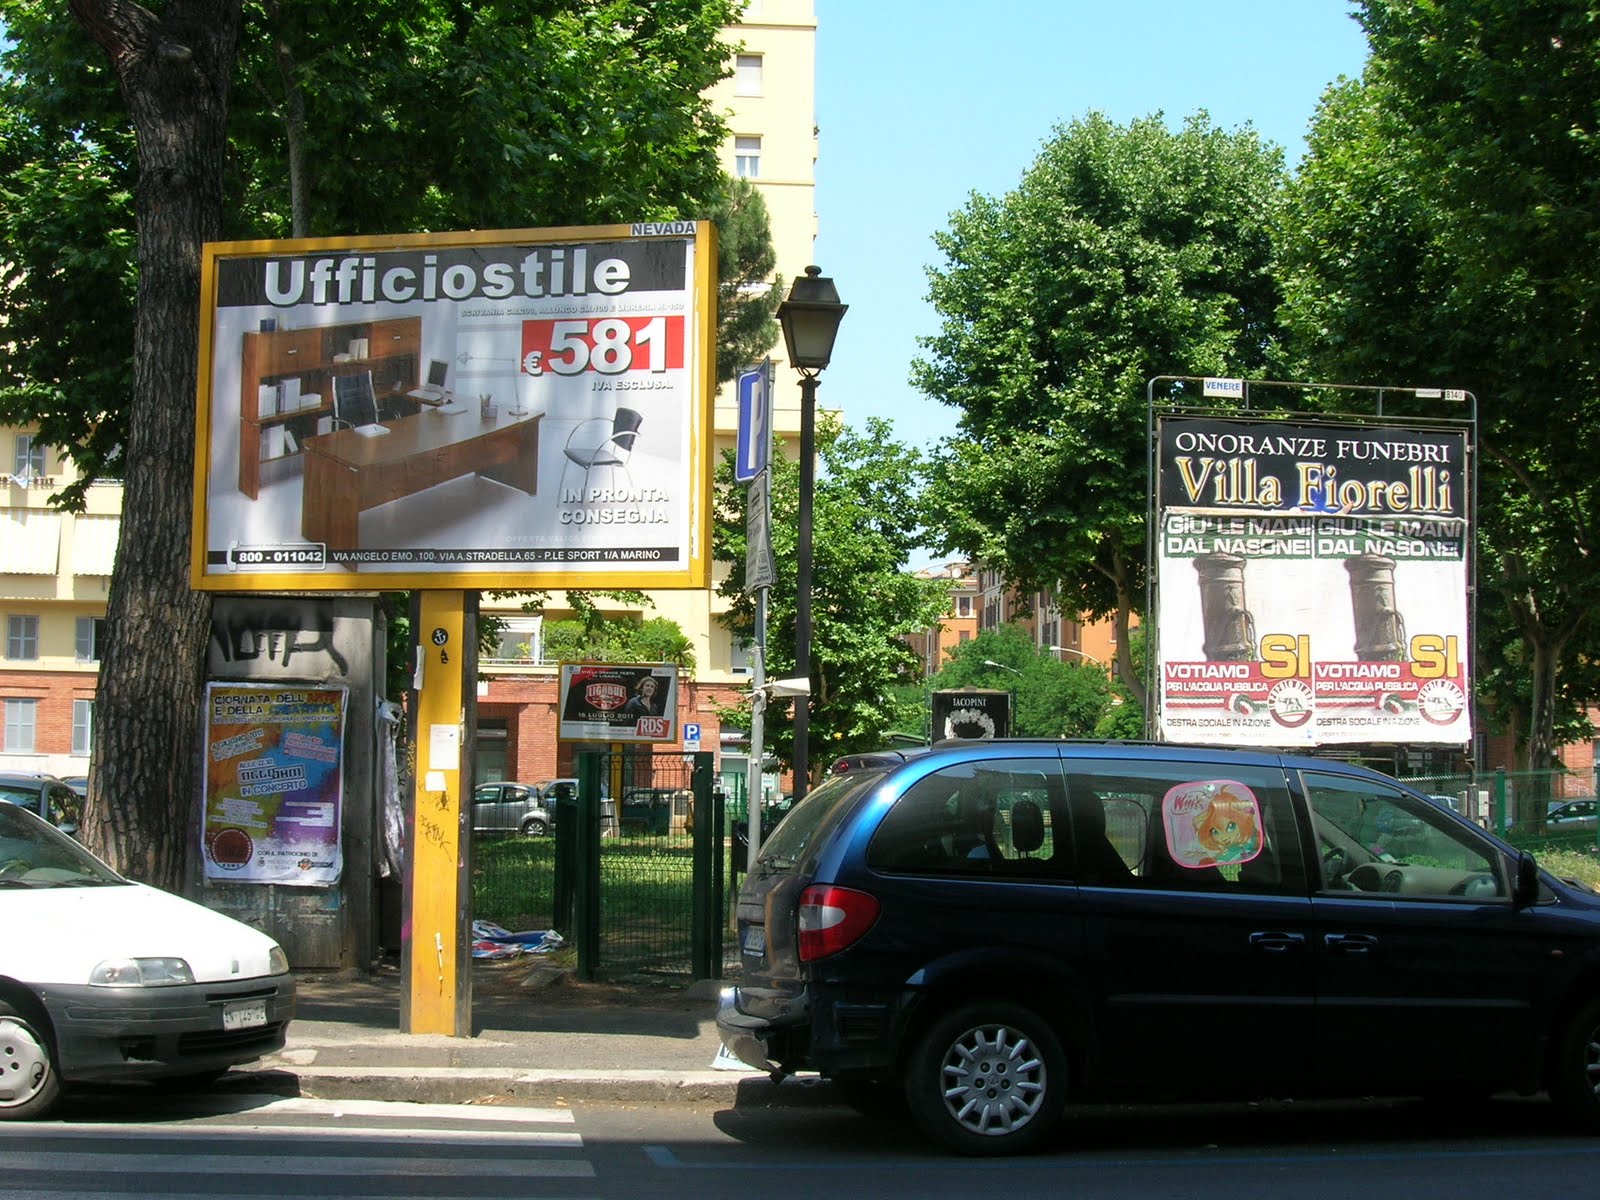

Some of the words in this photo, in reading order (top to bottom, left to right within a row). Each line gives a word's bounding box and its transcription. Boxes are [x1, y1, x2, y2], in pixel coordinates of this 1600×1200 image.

[632, 222, 695, 236] NEVADA
[264, 248, 632, 308] Ufficiostile
[547, 317, 667, 376] 581
[592, 381, 612, 392] IVA
[1205, 381, 1241, 391] VENERE
[1175, 432, 1328, 459] ONORANZE
[1336, 438, 1451, 464] FUNEBRI
[1174, 456, 1284, 507] Villa
[1295, 461, 1454, 514] Fiorelli
[563, 488, 587, 504] IN
[590, 487, 670, 503] PRONTA
[560, 508, 669, 525] CONSEGNA
[1218, 518, 1245, 534] LE
[1248, 518, 1311, 536] MANI
[1368, 519, 1395, 536] LE
[1400, 520, 1462, 538] MANI
[1168, 538, 1210, 554] DAL
[1213, 540, 1312, 556] NASONE!
[1318, 538, 1362, 556] DAL
[1364, 540, 1460, 557] NASONE!
[239, 551, 263, 562] 800
[274, 551, 322, 562] 011042
[333, 552, 350, 562] VIA
[350, 552, 390, 561] ANGELO
[392, 552, 413, 560] EMO
[440, 552, 455, 561] VIA
[567, 550, 602, 560] SPORT
[604, 550, 619, 560] 1/A
[620, 550, 660, 560] MARINO
[1260, 634, 1311, 678] SI
[1410, 634, 1459, 678] SI
[1166, 664, 1250, 678] VOTIAMO
[1316, 664, 1400, 678] VOTIAMO
[588, 684, 625, 697] LIGABUE
[1166, 682, 1183, 692] PER
[1224, 682, 1268, 692] PUBBLICA
[1316, 682, 1334, 691] PER
[1375, 682, 1418, 691] PUBBLICA
[214, 695, 270, 705] GIORNATA
[953, 698, 986, 706] IACOPINI
[228, 706, 264, 715] DELLA
[640, 718, 664, 733] RDS
[1167, 718, 1198, 727] DESTRA
[1198, 718, 1232, 727] SOCIALE
[1232, 718, 1241, 727] IN
[1242, 719, 1271, 727] AZIONE
[1316, 718, 1348, 726] DESTRA
[1349, 718, 1382, 726] SOCIALE
[686, 725, 698, 739] P
[242, 787, 252, 796] IN
[254, 780, 308, 794] CONCERTO
